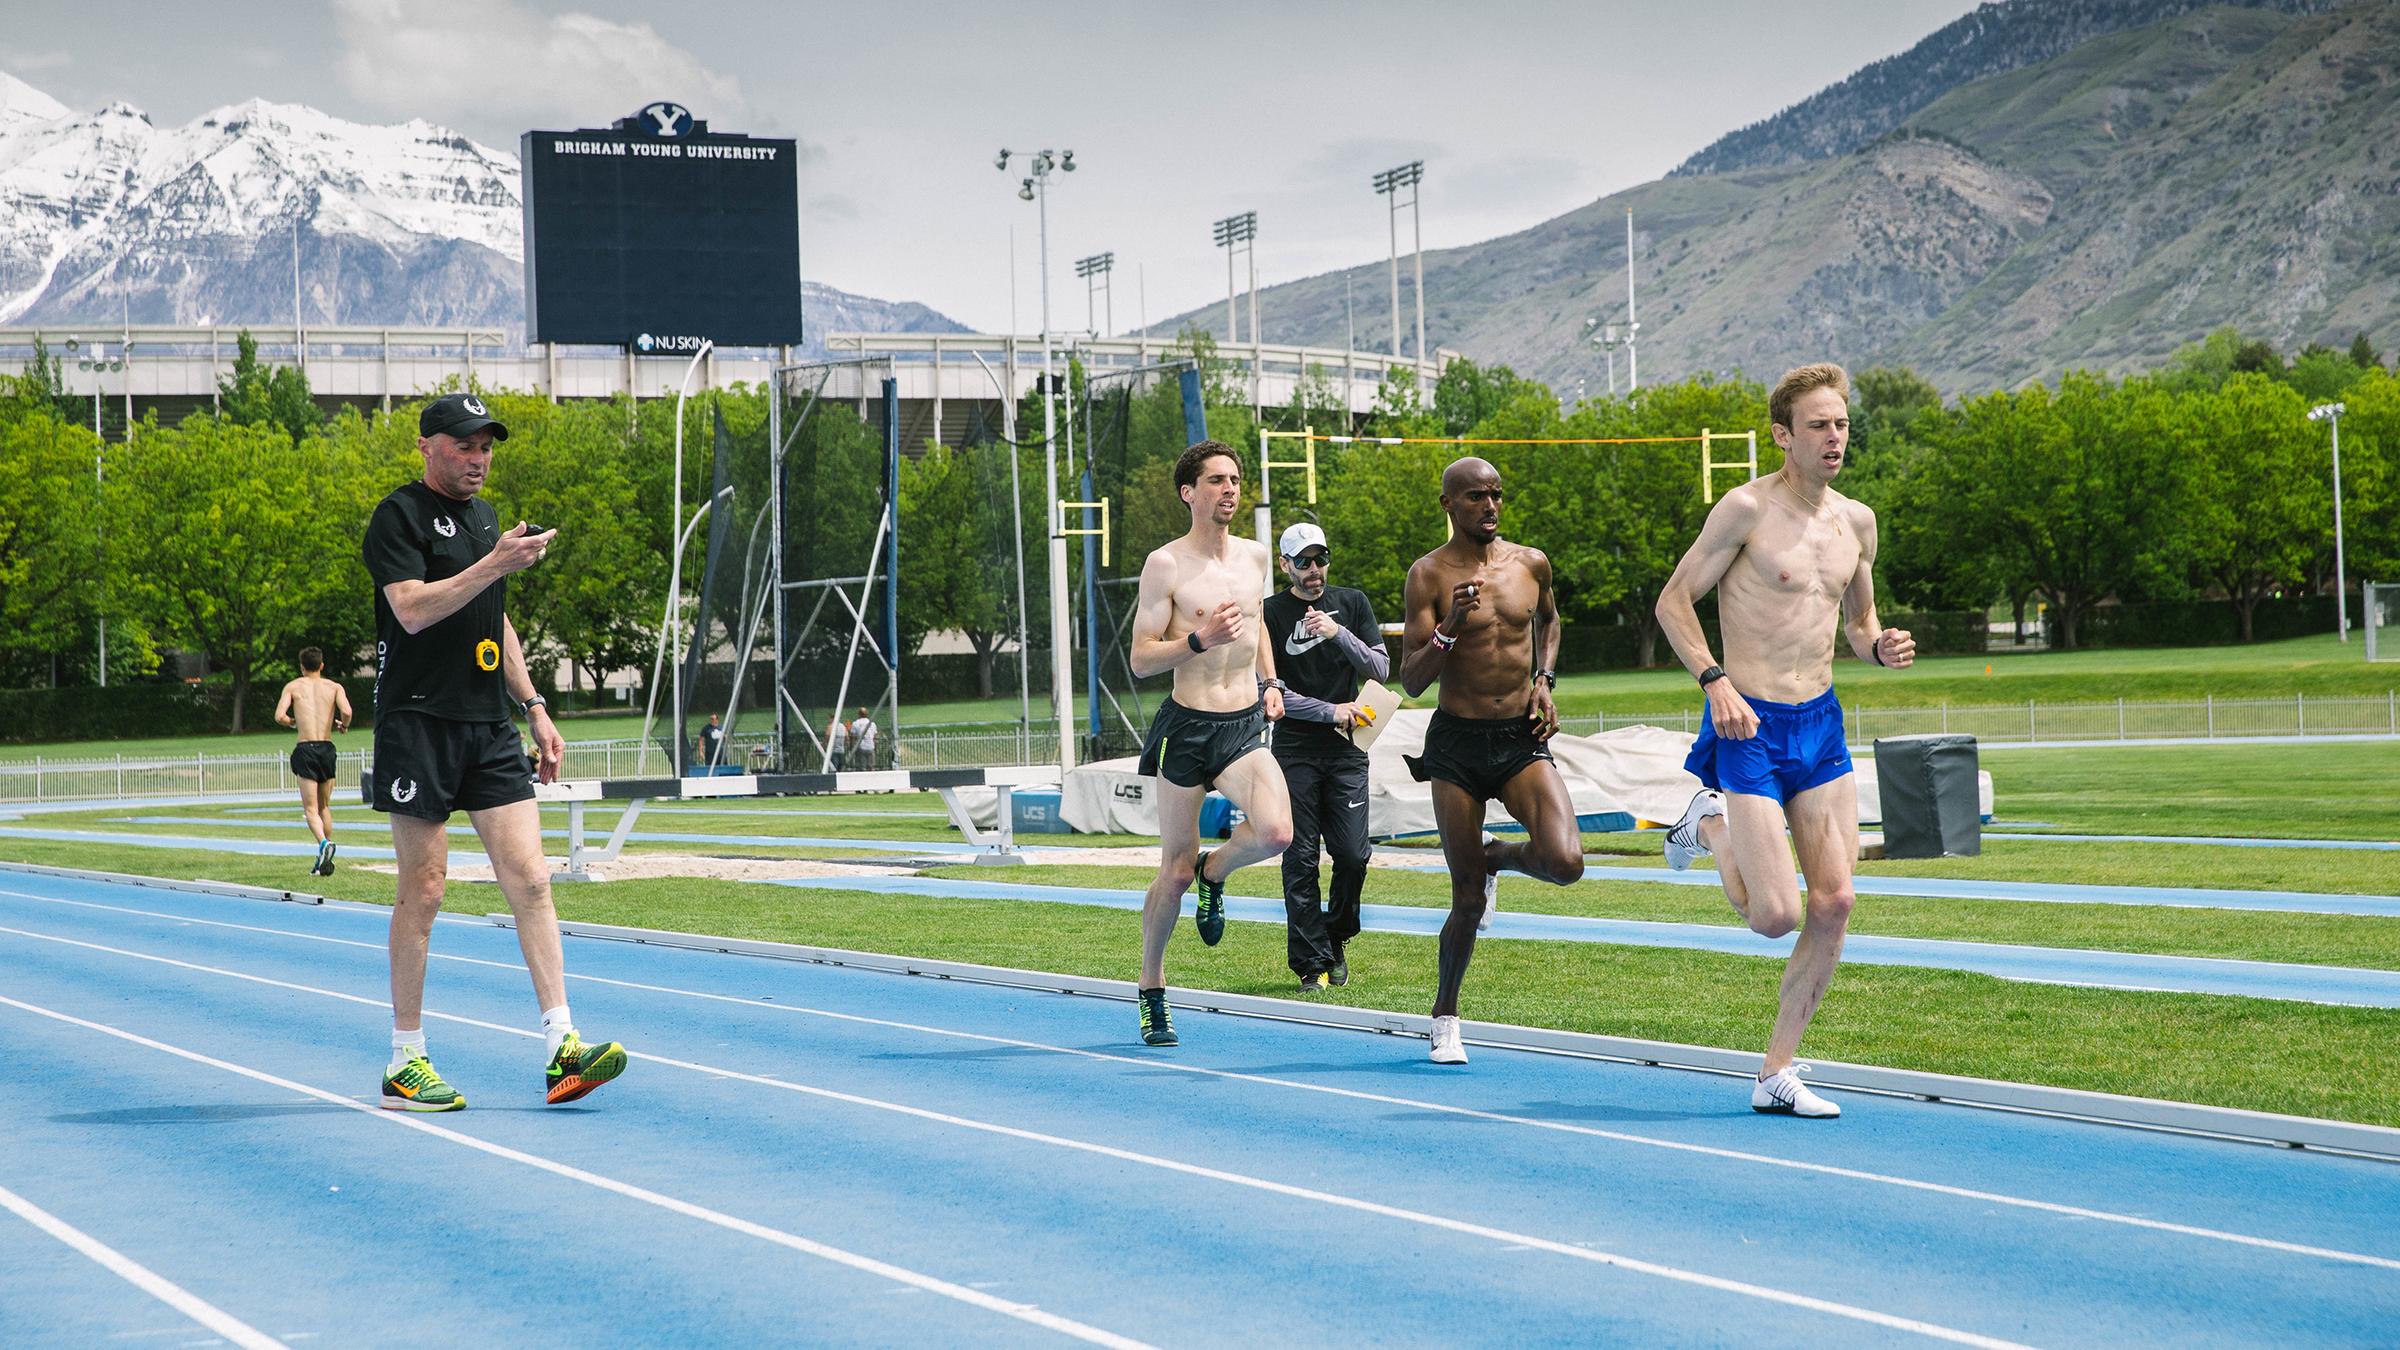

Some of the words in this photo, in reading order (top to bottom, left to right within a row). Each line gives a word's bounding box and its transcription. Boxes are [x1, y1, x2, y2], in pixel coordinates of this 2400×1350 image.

[646, 104, 687, 137] Y
[554, 141, 626, 155] BRIGHAM
[631, 143, 681, 157] YOUNG
[687, 145, 777, 160] UNIVERSITY
[656, 335, 675, 350] NU
[677, 335, 706, 350] SKIN
[1114, 783, 1143, 799] UCS
[1022, 805, 1045, 820] UCS
